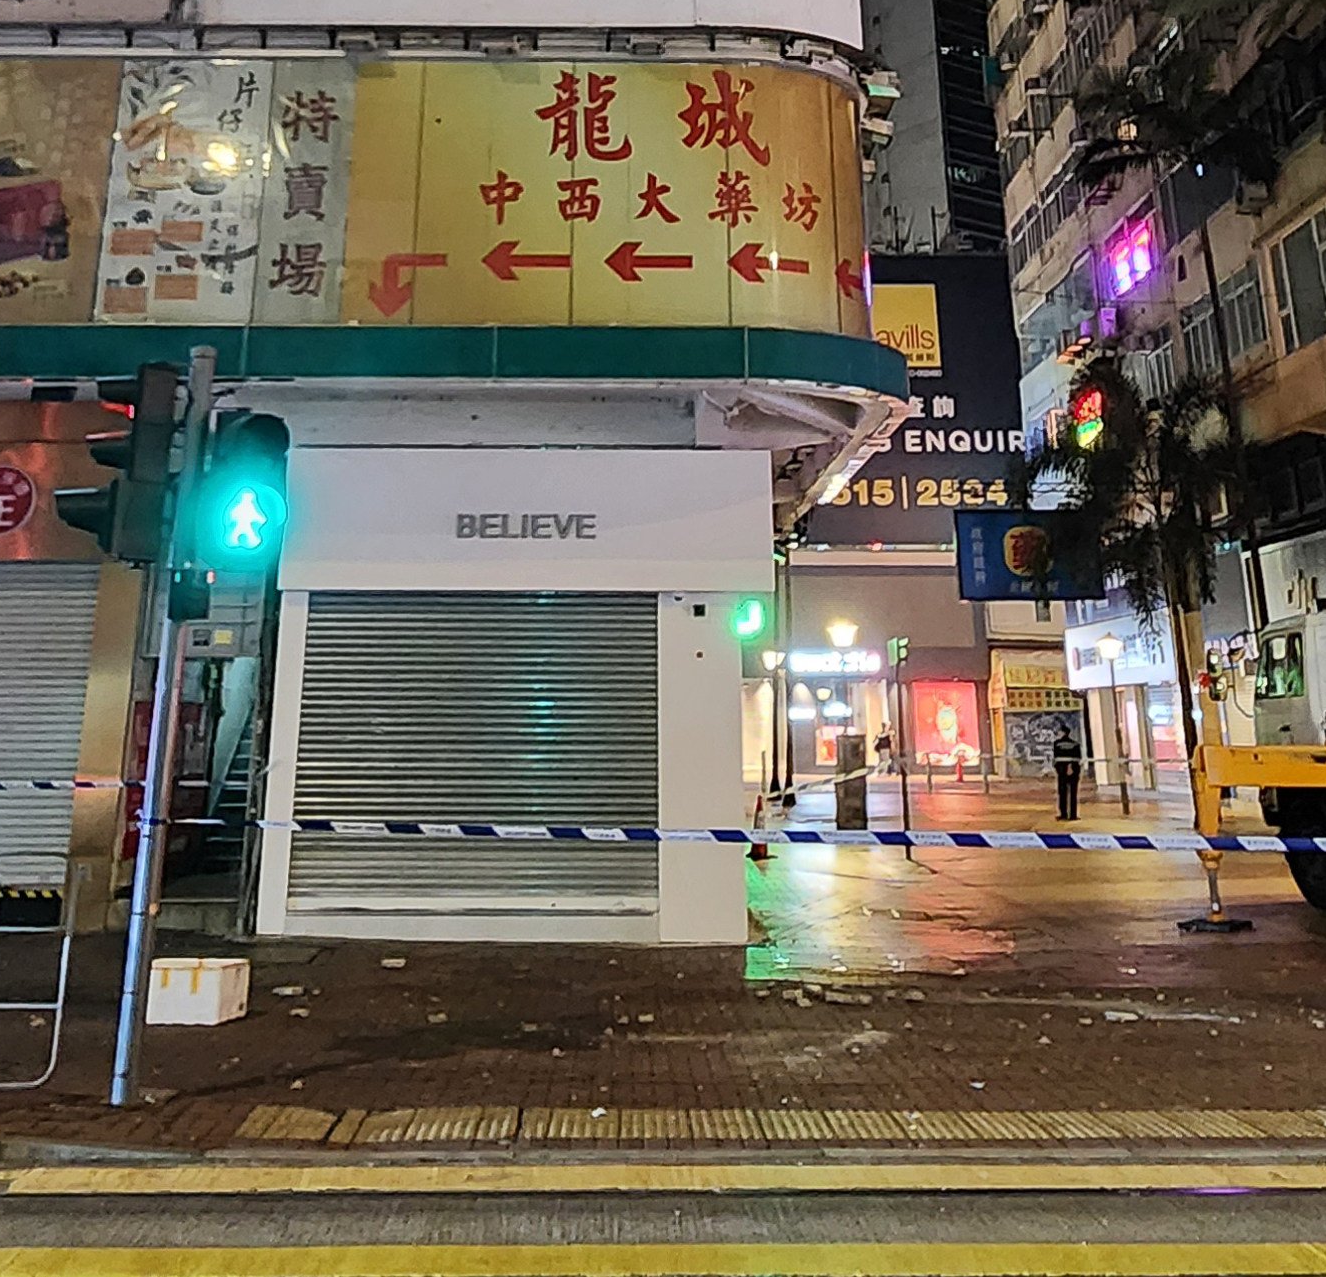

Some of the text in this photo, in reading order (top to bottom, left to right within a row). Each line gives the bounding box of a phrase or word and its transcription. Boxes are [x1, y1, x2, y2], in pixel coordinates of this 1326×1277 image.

[535, 69, 771, 164] 龍城
[269, 90, 340, 298] 特賣場
[480, 170, 823, 231] 中西大藥坊
[876, 324, 935, 349] avills
[456, 513, 597, 540] BELIEVE
